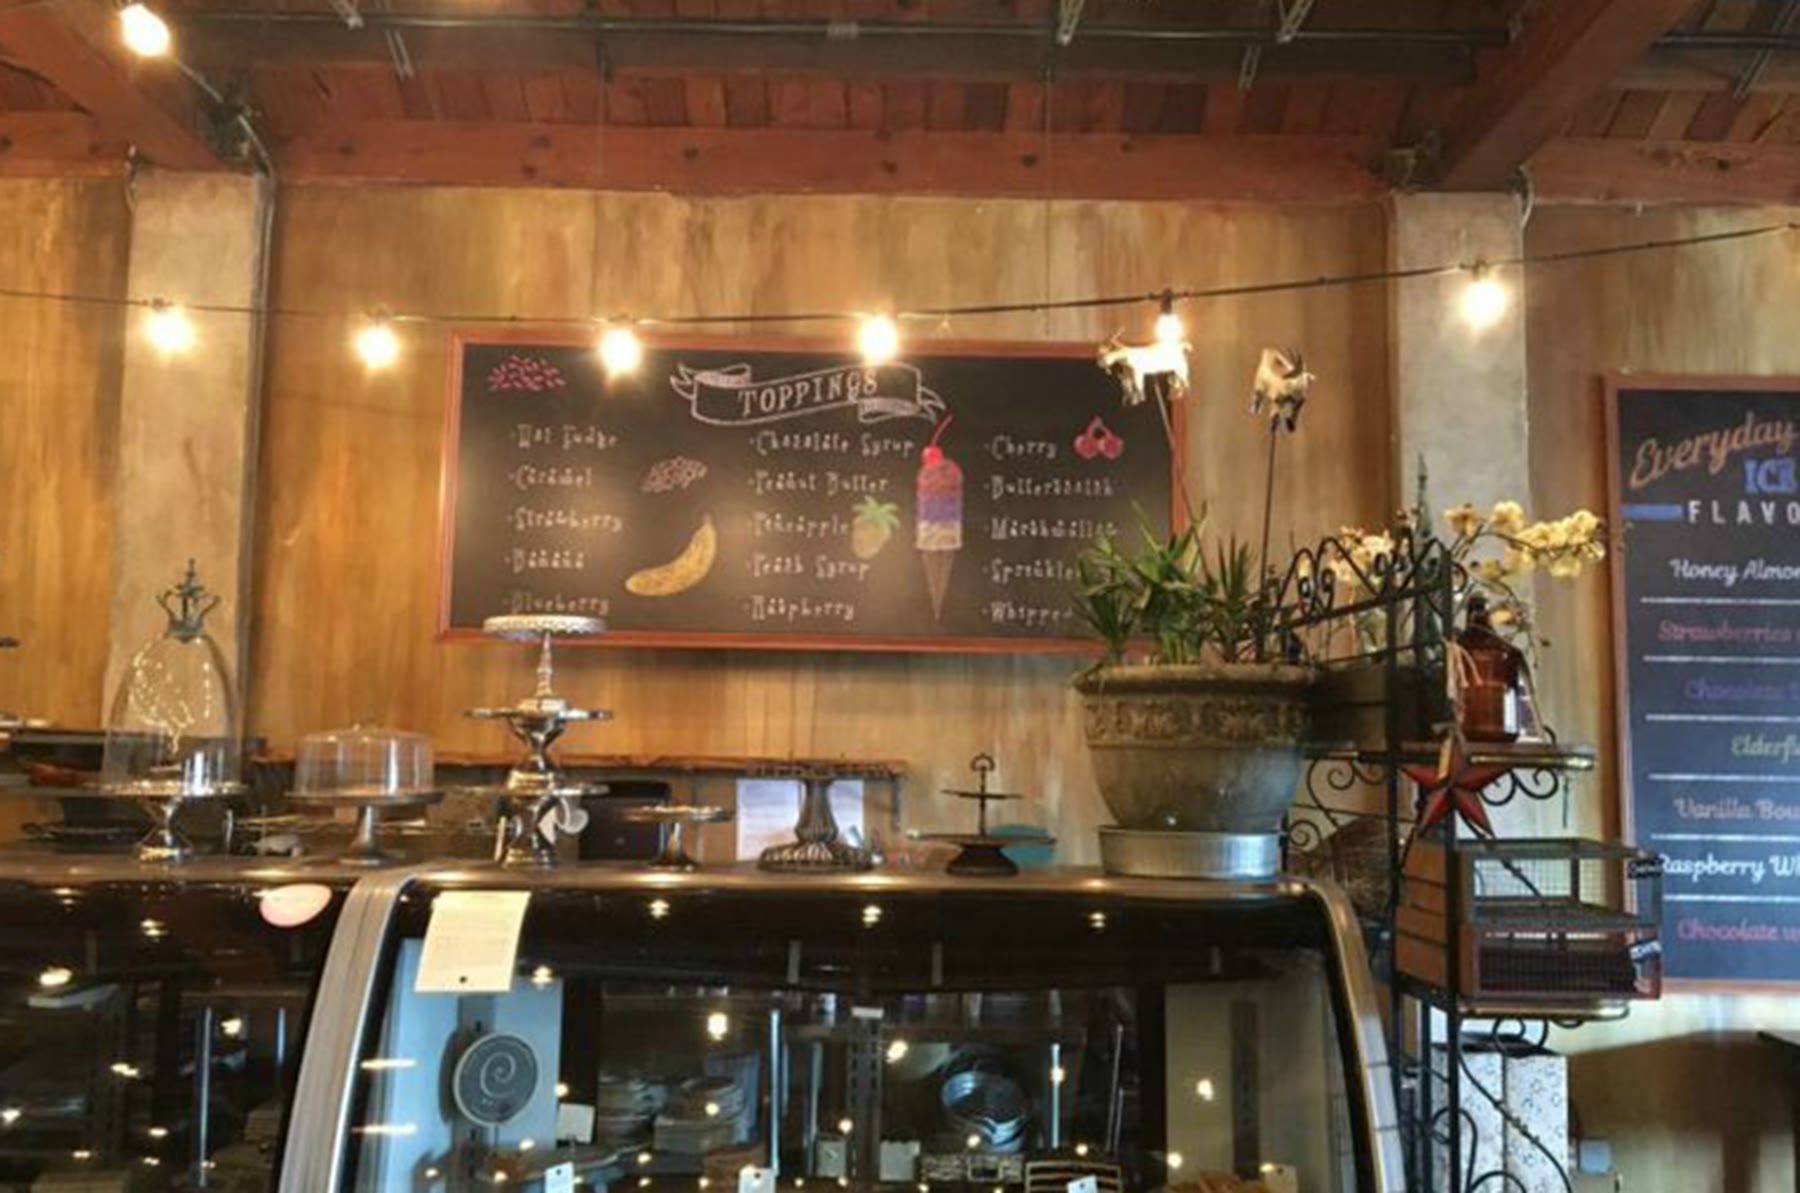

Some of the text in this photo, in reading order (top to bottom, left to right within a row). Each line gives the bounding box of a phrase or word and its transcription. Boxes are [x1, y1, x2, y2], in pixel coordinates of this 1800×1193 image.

[738, 368, 878, 418] TOPPINGS
[992, 434, 1057, 461] Cherry
[1629, 409, 1799, 490] Everyday
[1669, 558, 1738, 587] Honey
[1674, 797, 1751, 819] Vanilla
[1660, 852, 1765, 884] Raspberry
